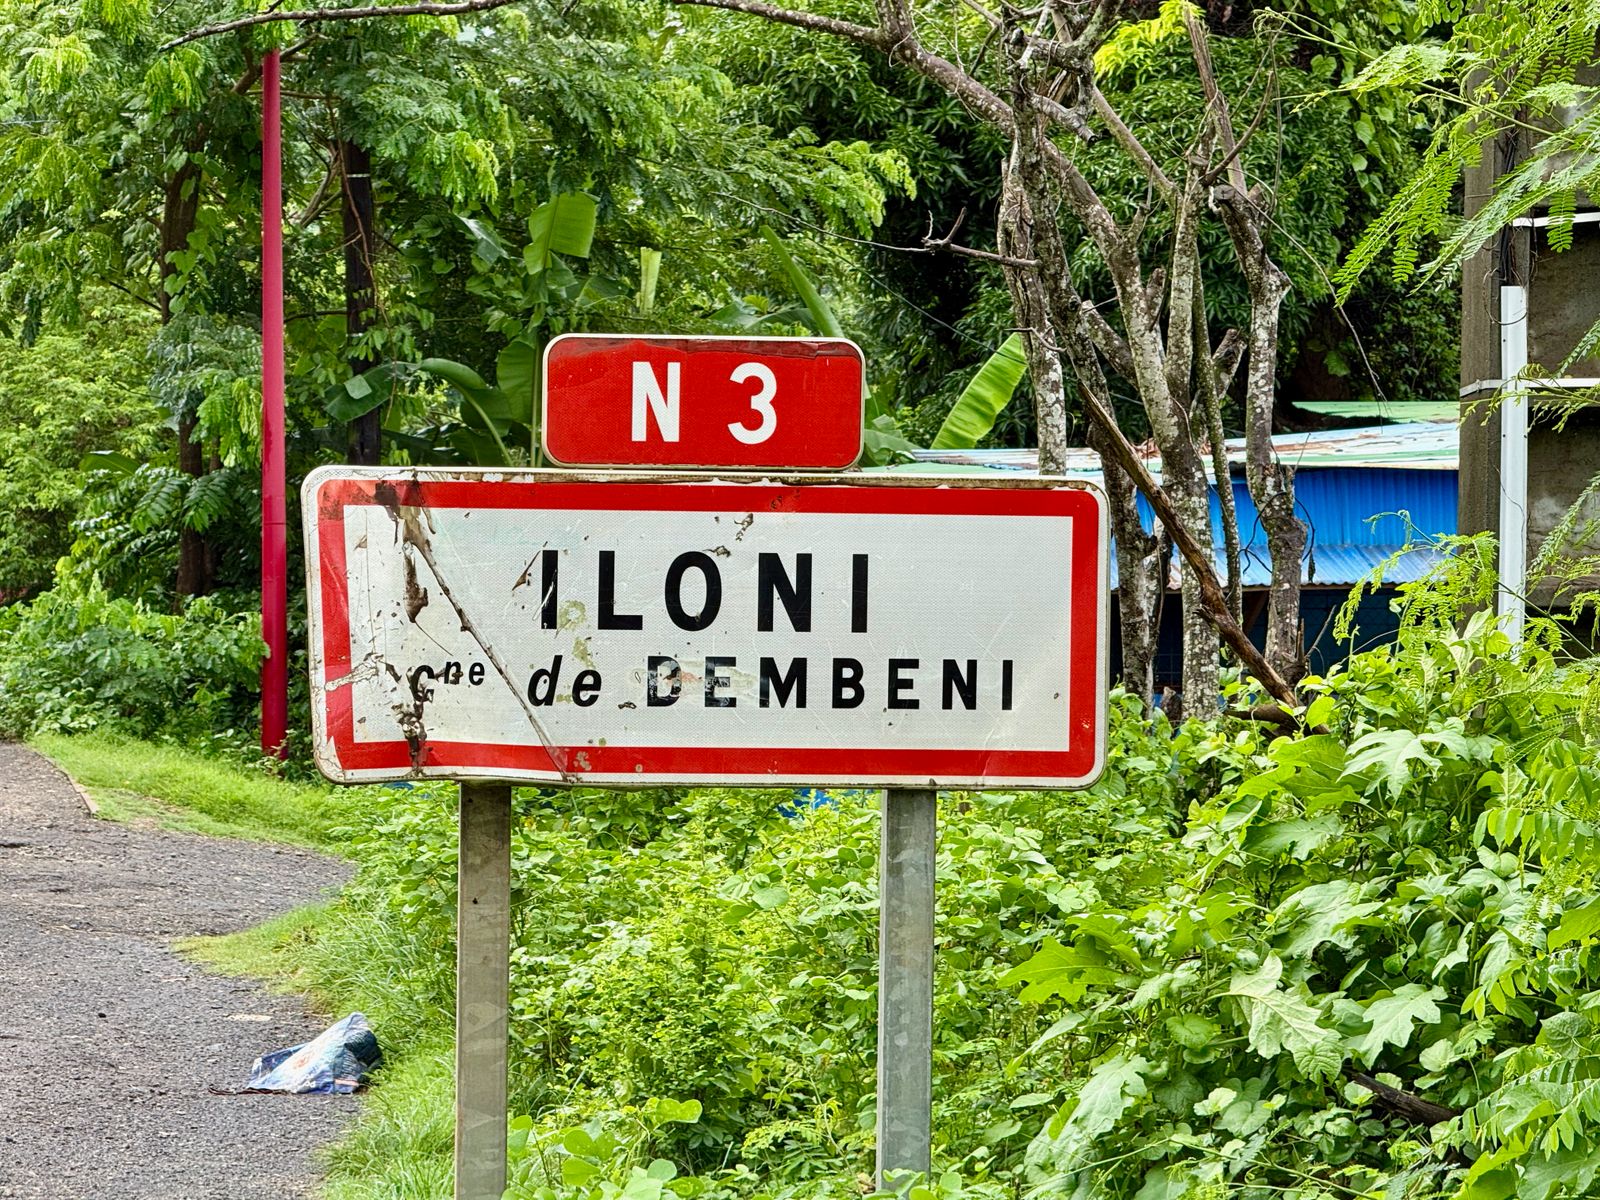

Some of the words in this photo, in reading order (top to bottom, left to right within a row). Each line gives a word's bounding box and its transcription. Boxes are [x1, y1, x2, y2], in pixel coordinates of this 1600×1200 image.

[631, 361, 681, 442] N
[728, 361, 777, 445] 3
[541, 549, 869, 633] ILONI
[528, 654, 602, 707] de
[647, 655, 1013, 710] DEMBENI
